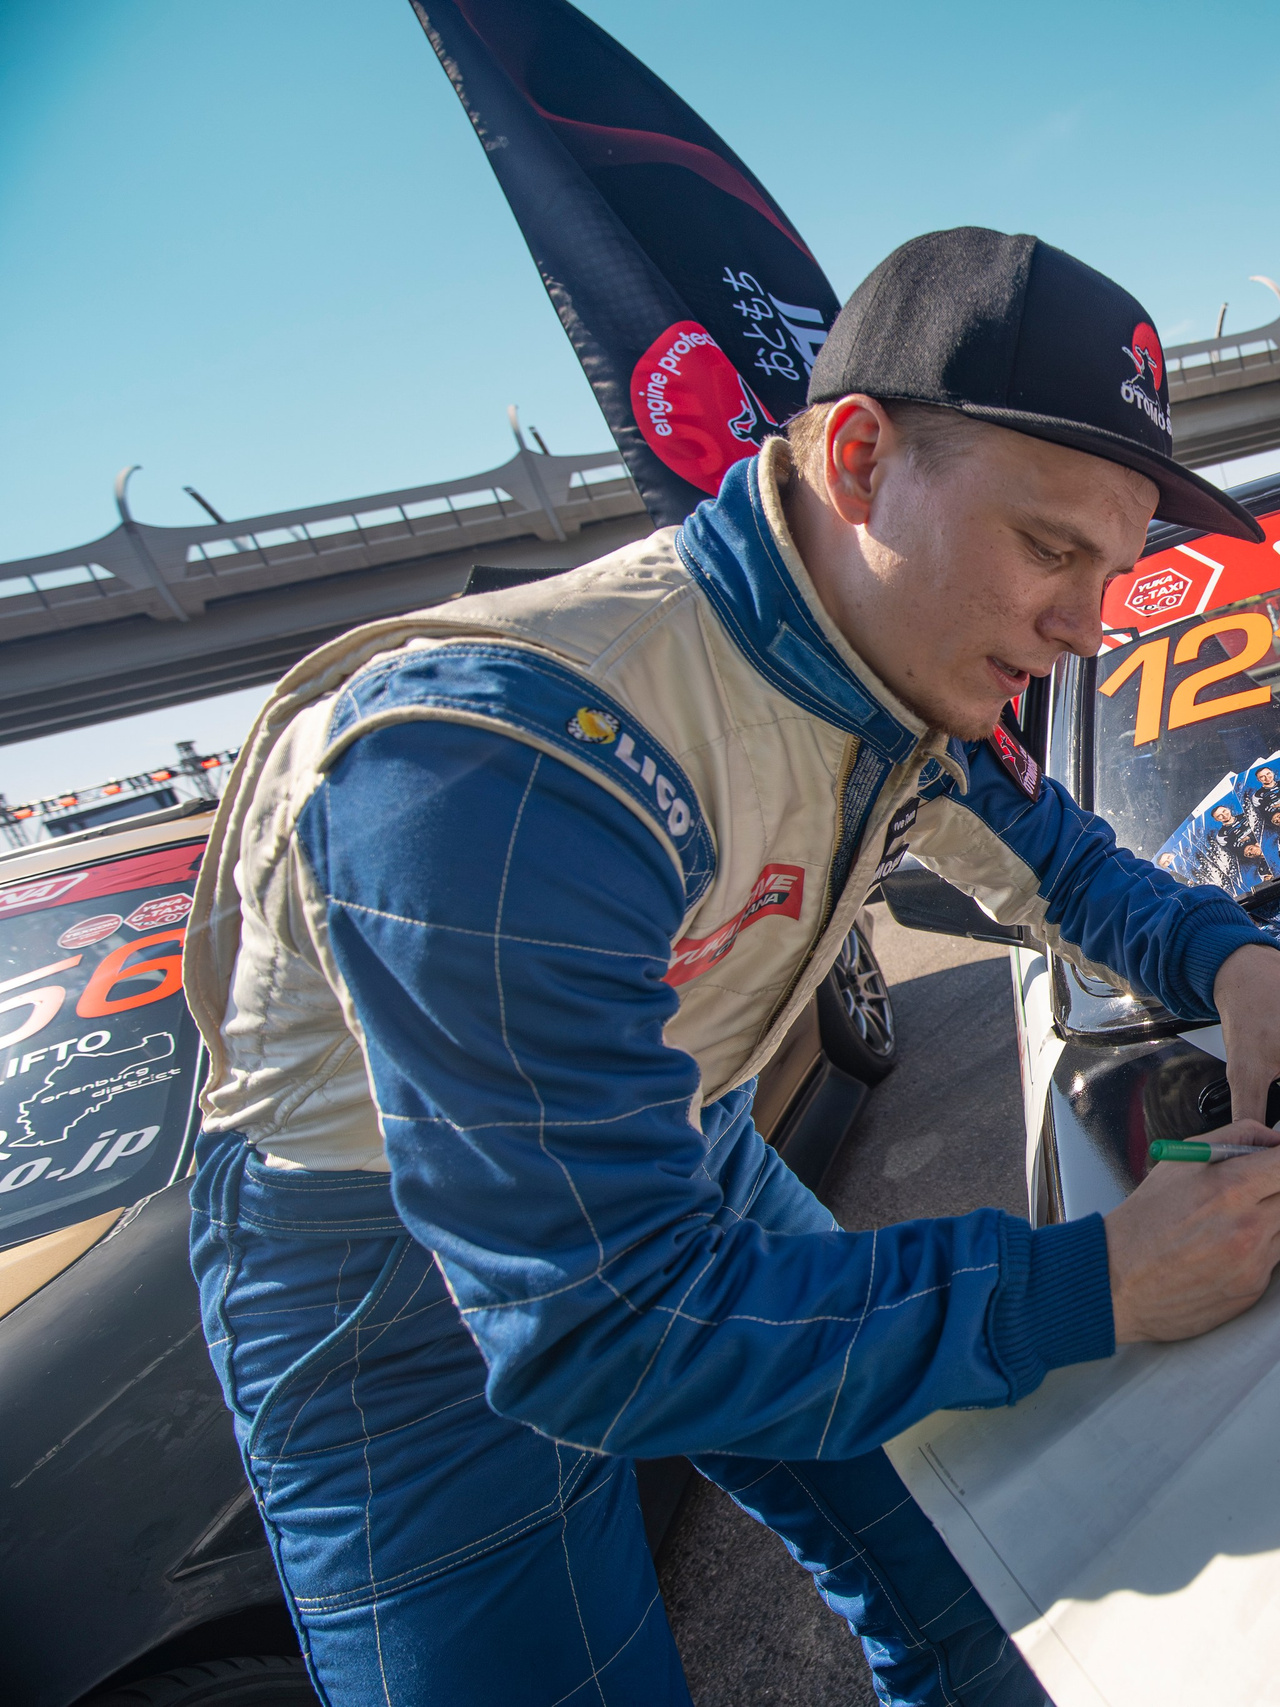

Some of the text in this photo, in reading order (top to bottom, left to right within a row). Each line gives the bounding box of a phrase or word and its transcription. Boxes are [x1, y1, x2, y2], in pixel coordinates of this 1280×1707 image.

[638, 372, 674, 437] engine
[1132, 581, 1184, 605] G-TAXI
[1138, 575, 1173, 592] YUKA
[615, 733, 692, 837] LICO
[142, 898, 183, 912] YUKA
[41, 1067, 149, 1104] orenburg
[92, 1068, 181, 1098] district
